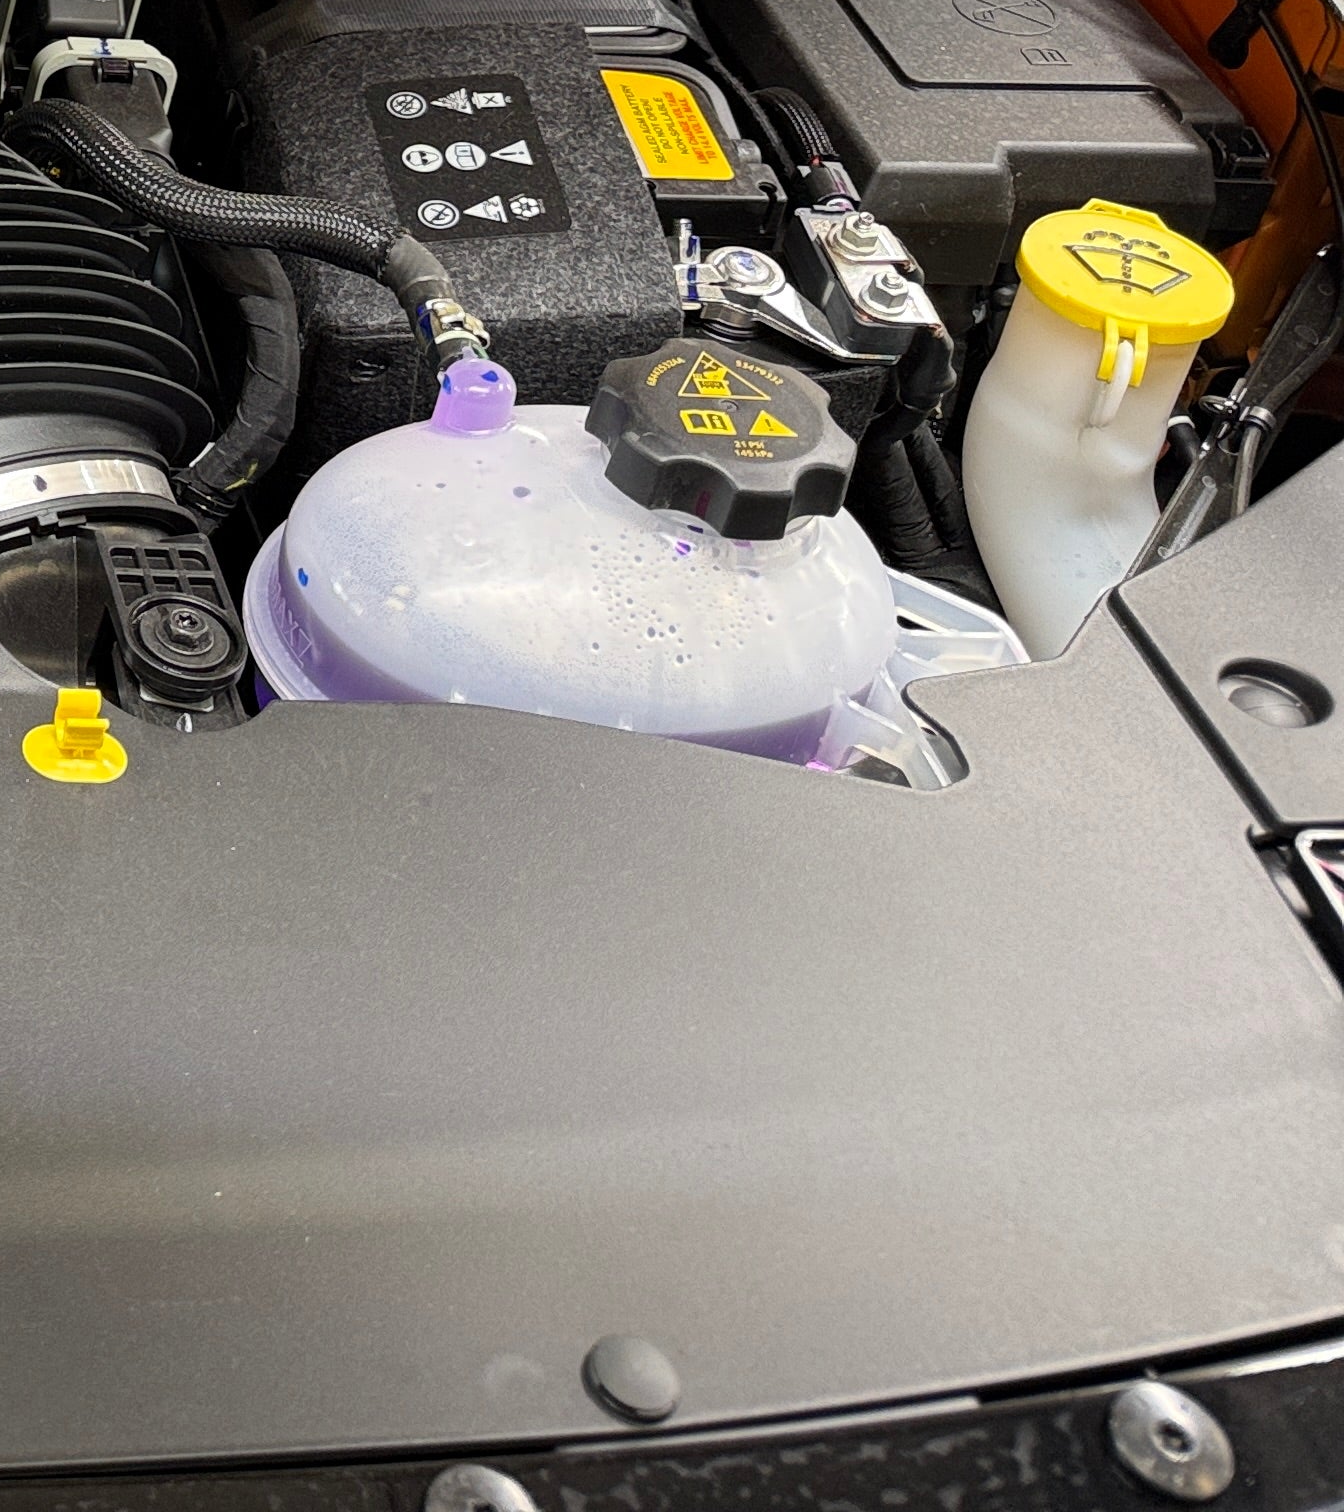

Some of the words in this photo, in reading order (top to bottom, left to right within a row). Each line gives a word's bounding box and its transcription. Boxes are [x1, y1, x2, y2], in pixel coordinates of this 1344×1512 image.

[620, 84, 643, 117] BATTERY
[662, 91, 683, 122] VOLTAGE
[636, 117, 652, 135] AGM
[652, 122, 665, 138] NOT
[653, 97, 690, 155] NON-SPILLABLE
[678, 120, 699, 146] CHARGE
[687, 114, 704, 135] VOLTS
[645, 134, 667, 164] SEALED
[660, 138, 672, 150] DO
[692, 147, 709, 164] LIMIT
[703, 150, 717, 159] TO
[734, 440, 747, 449] 21
[734, 449, 755, 459] 145
[755, 450, 774, 458] kPa
